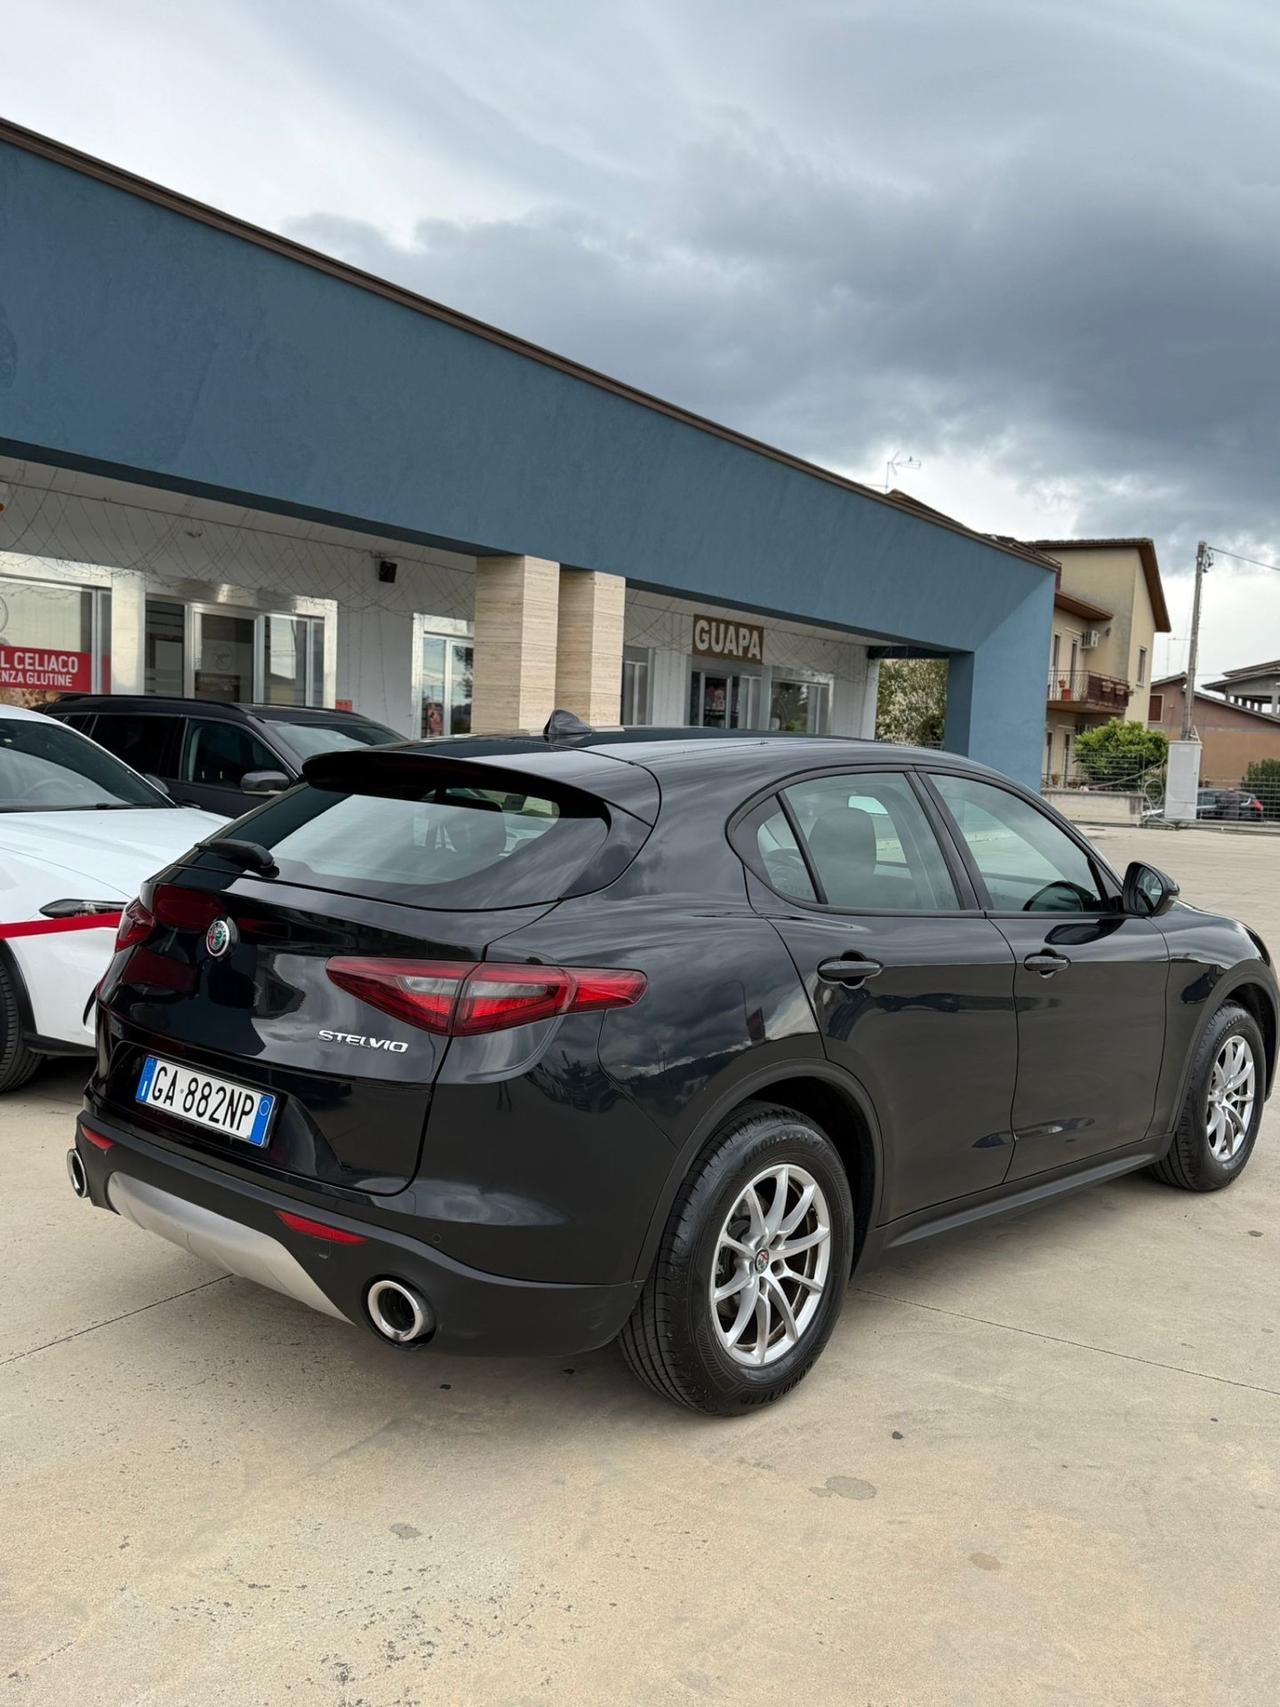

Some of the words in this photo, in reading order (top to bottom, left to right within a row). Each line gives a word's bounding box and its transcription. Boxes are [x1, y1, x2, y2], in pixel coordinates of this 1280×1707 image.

[695, 619, 761, 659] GUAPA
[14, 652, 78, 673] CELIACO
[0, 670, 24, 684] NZA
[26, 672, 73, 687] GLUTINE
[318, 1029, 409, 1053] STELVIO
